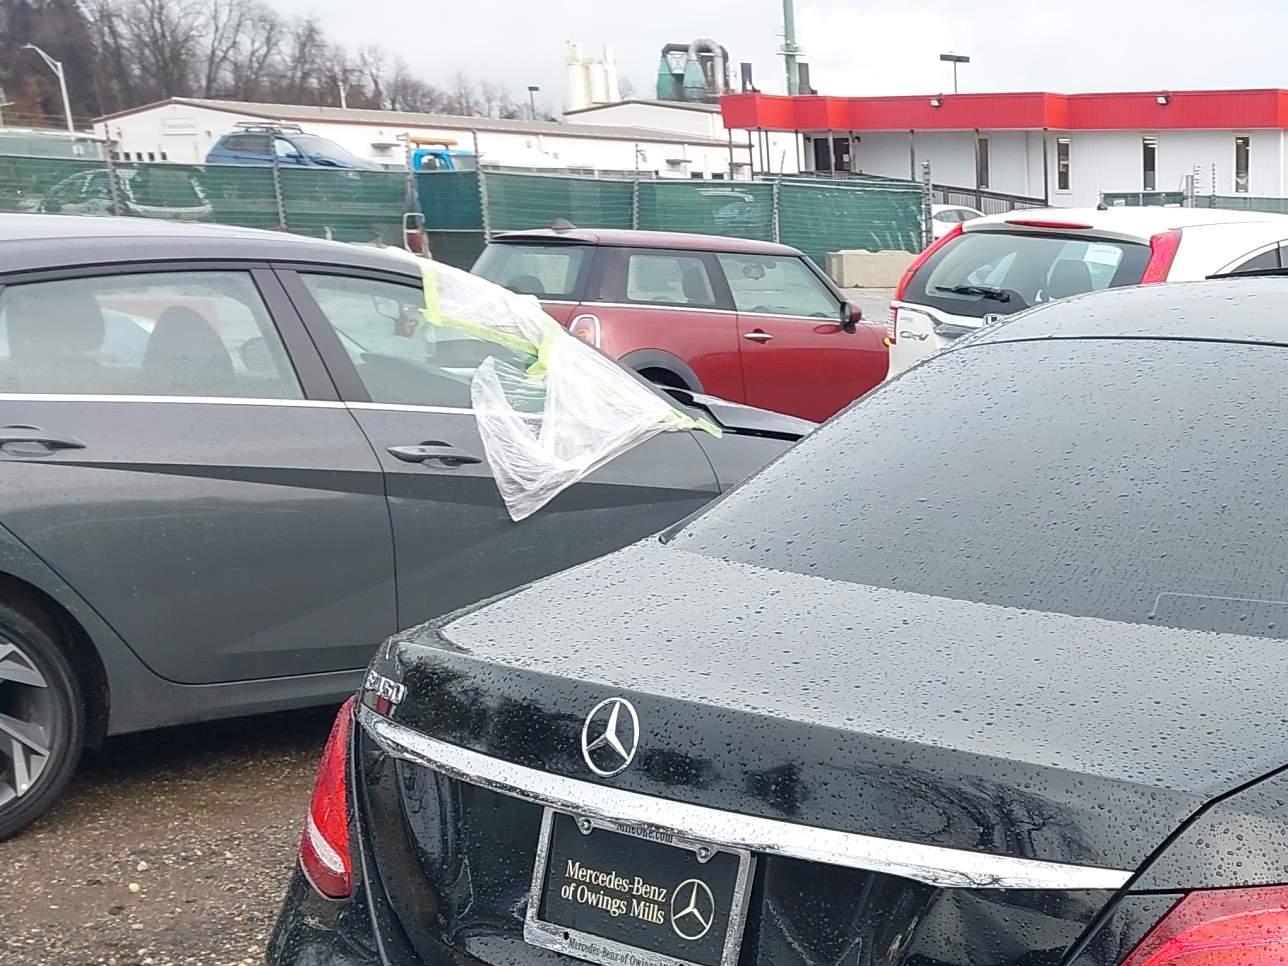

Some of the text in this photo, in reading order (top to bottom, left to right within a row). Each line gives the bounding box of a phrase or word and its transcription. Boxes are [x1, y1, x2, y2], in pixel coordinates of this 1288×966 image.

[565, 859, 668, 902] Mercedes-Benz
[561, 882, 665, 924] of Owings Mills
[568, 937, 618, 962] Mercedes-Benz
[620, 951, 630, 965] of
